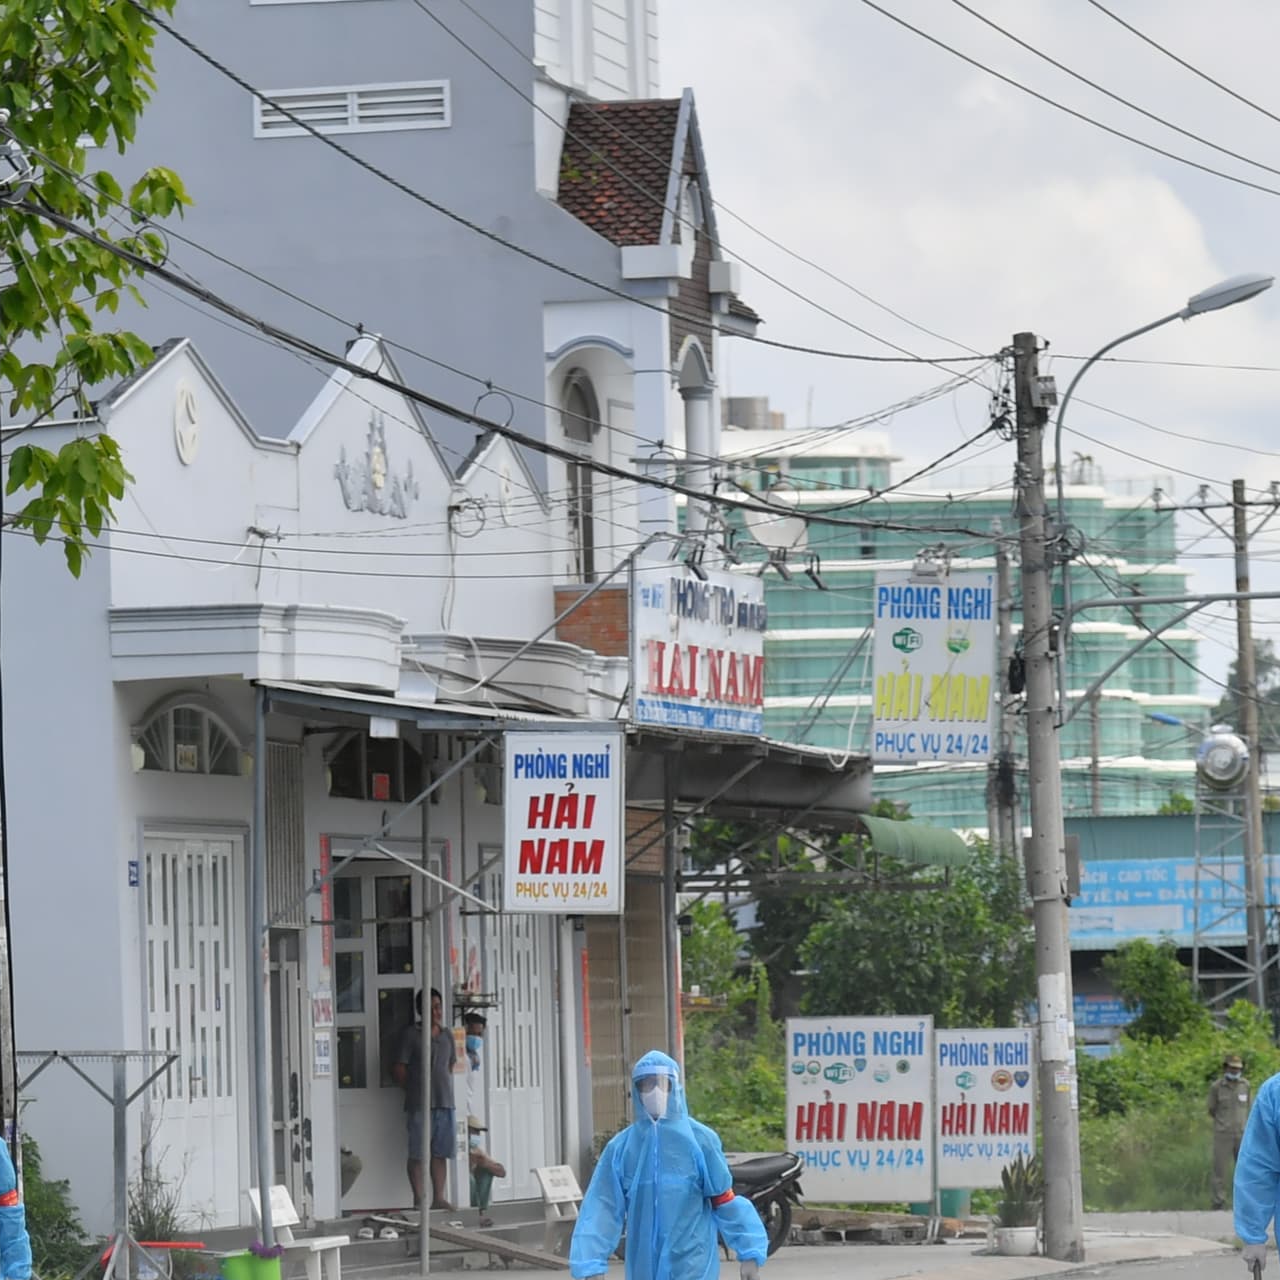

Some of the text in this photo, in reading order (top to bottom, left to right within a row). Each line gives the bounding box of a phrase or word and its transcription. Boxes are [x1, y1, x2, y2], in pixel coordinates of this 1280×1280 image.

[947, 575, 993, 621] NGHỈ
[701, 647, 766, 707] NAM
[875, 657, 991, 723] HẢI NAM
[513, 743, 611, 779] PHÒNG NGHỈ
[875, 732, 989, 760] PHỤC VỤ 24/24
[527, 782, 597, 829] HẢI
[518, 838, 606, 875] NAM
[515, 881, 608, 903] PHỤC VỤ 24/24
[792, 1022, 926, 1057] PHÒNG NGHỈ
[938, 1033, 1030, 1067] PHÒNG NGHỈ
[795, 1089, 924, 1142] HẢI NAM
[940, 1092, 1030, 1136] HẢI NAM
[846, 1149, 870, 1172] VỤ
[876, 1148, 925, 1168] 24/24
[942, 1142, 975, 1162] PHỤC
[976, 1143, 993, 1161] VỤ
